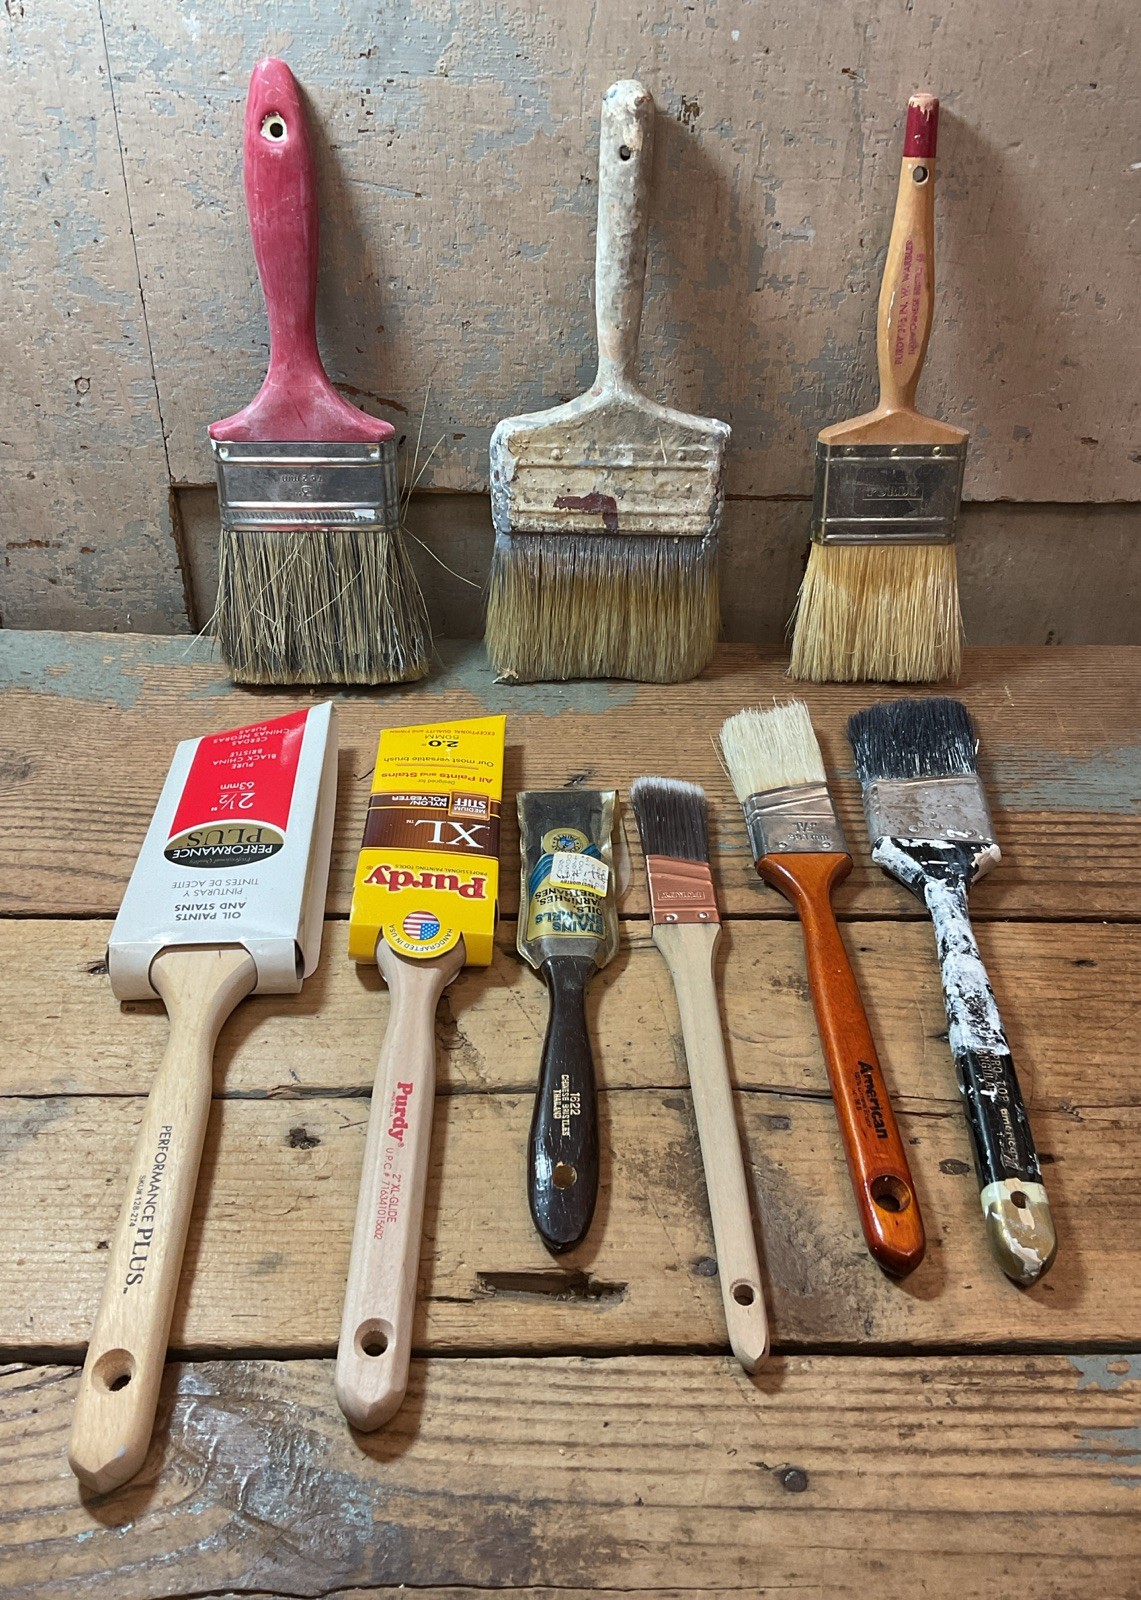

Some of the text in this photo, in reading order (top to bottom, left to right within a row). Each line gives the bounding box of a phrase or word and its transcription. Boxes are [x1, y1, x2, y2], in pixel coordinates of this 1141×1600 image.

[895, 336, 904, 364] PURDY
[902, 240, 913, 282] WARBLER
[213, 728, 289, 744] CHINAS NEGRAS
[239, 725, 267, 734] PURAS
[232, 737, 268, 746] CERDAS
[230, 749, 262, 757] BRISTLE
[212, 754, 276, 766] BLACK CHINA
[439, 773, 475, 782] Paints
[220, 782, 254, 790] 63mm
[454, 798, 486, 808] STIFF
[454, 806, 485, 814] MEDIUM
[172, 845, 273, 858] PERFORMANCE
[445, 868, 487, 876] PROFESSIONAL
[172, 880, 206, 889] ACEITE
[227, 878, 259, 886] TINTES
[193, 888, 243, 896] PINTURAS
[174, 902, 246, 911] AND STAINS
[176, 912, 241, 921] OIL PAINTS
[535, 911, 603, 924] ENAMELS
[389, 924, 397, 937] USA
[553, 922, 603, 935] STAINS
[404, 929, 452, 951] HANDCRAFTED
[561, 1074, 569, 1101] CHINESE
[553, 1090, 561, 1119] THAILAND
[570, 1092, 580, 1115] 1622
[858, 1061, 888, 1139] American
[142, 1125, 172, 1222] PERFORMANCE
[129, 1175, 146, 1227] SKU# 128-274
[387, 1184, 400, 1223] XL-GLIDE
[374, 1181, 390, 1240] 716341015602
